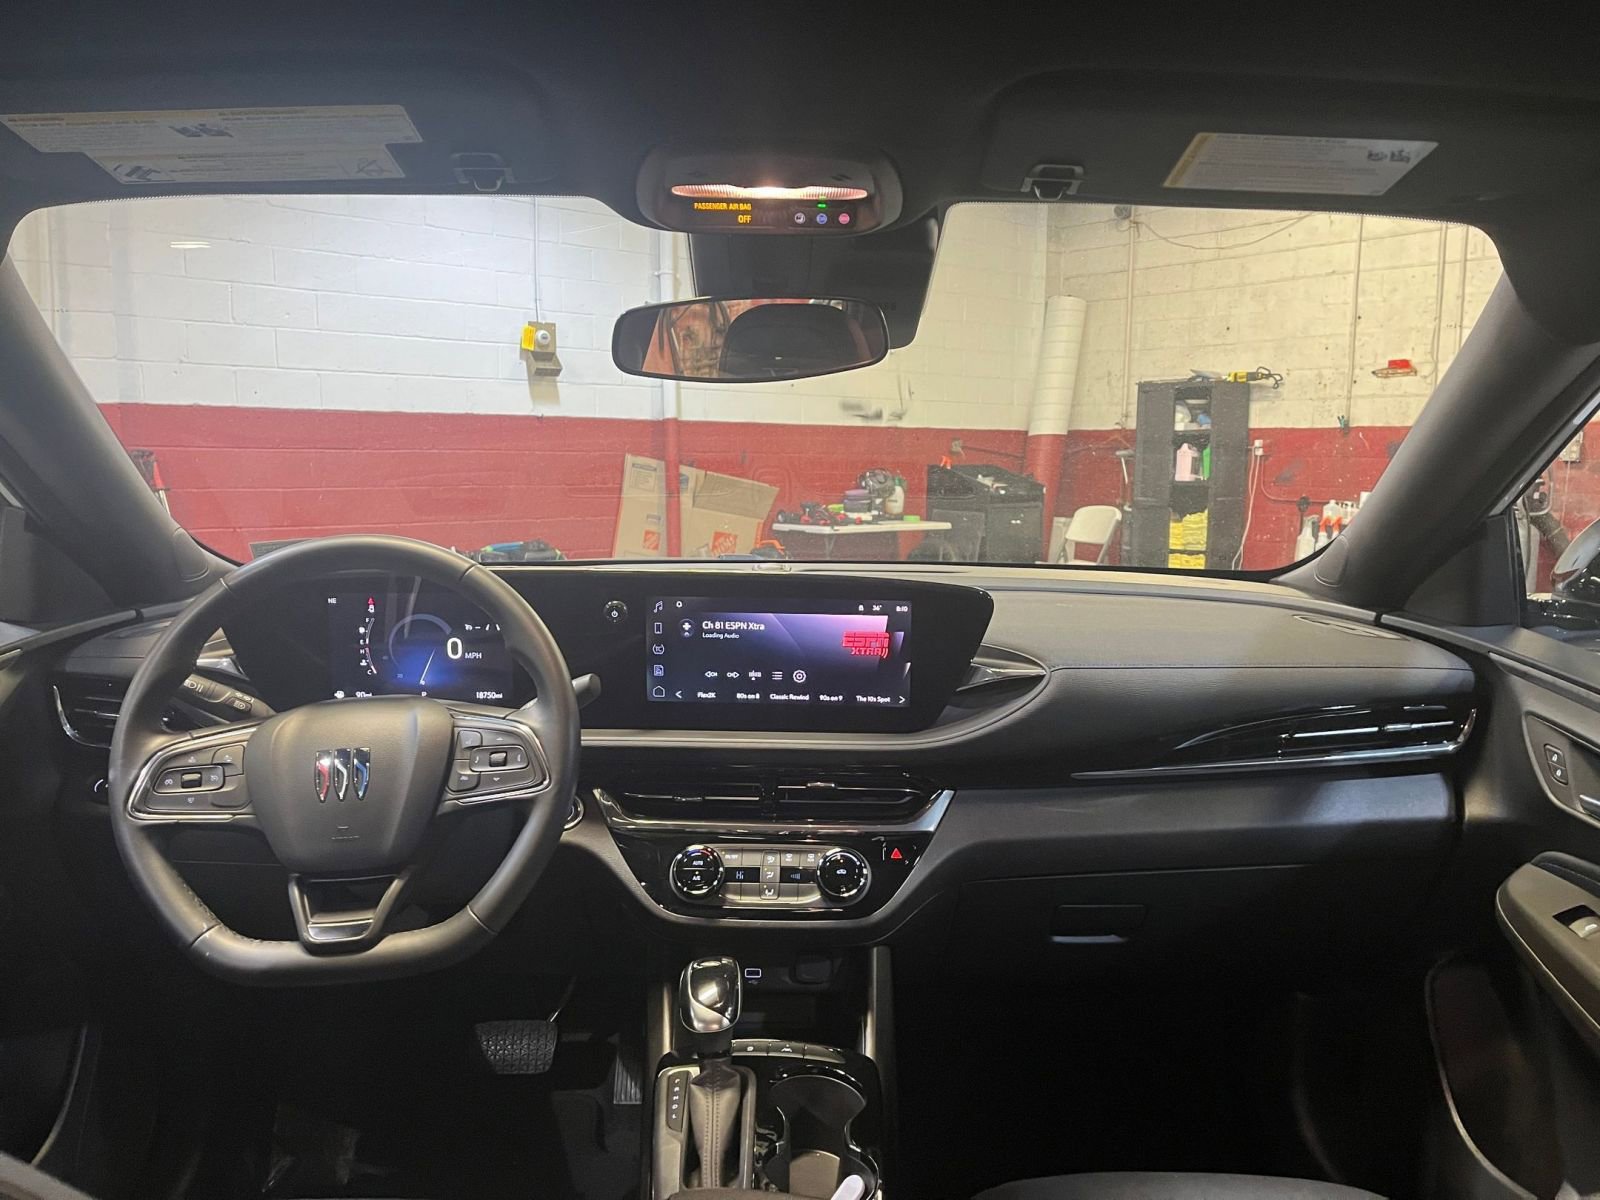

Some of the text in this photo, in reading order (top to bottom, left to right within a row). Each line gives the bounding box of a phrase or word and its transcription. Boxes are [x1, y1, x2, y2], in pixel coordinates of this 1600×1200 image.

[694, 202, 727, 210] PASSENGER
[738, 214, 752, 224] OFF
[702, 621, 766, 631] Ch 81 ESPN Xtra
[843, 632, 889, 647] ESPN
[446, 637, 463, 660] 0
[789, 693, 810, 701] Rewind
